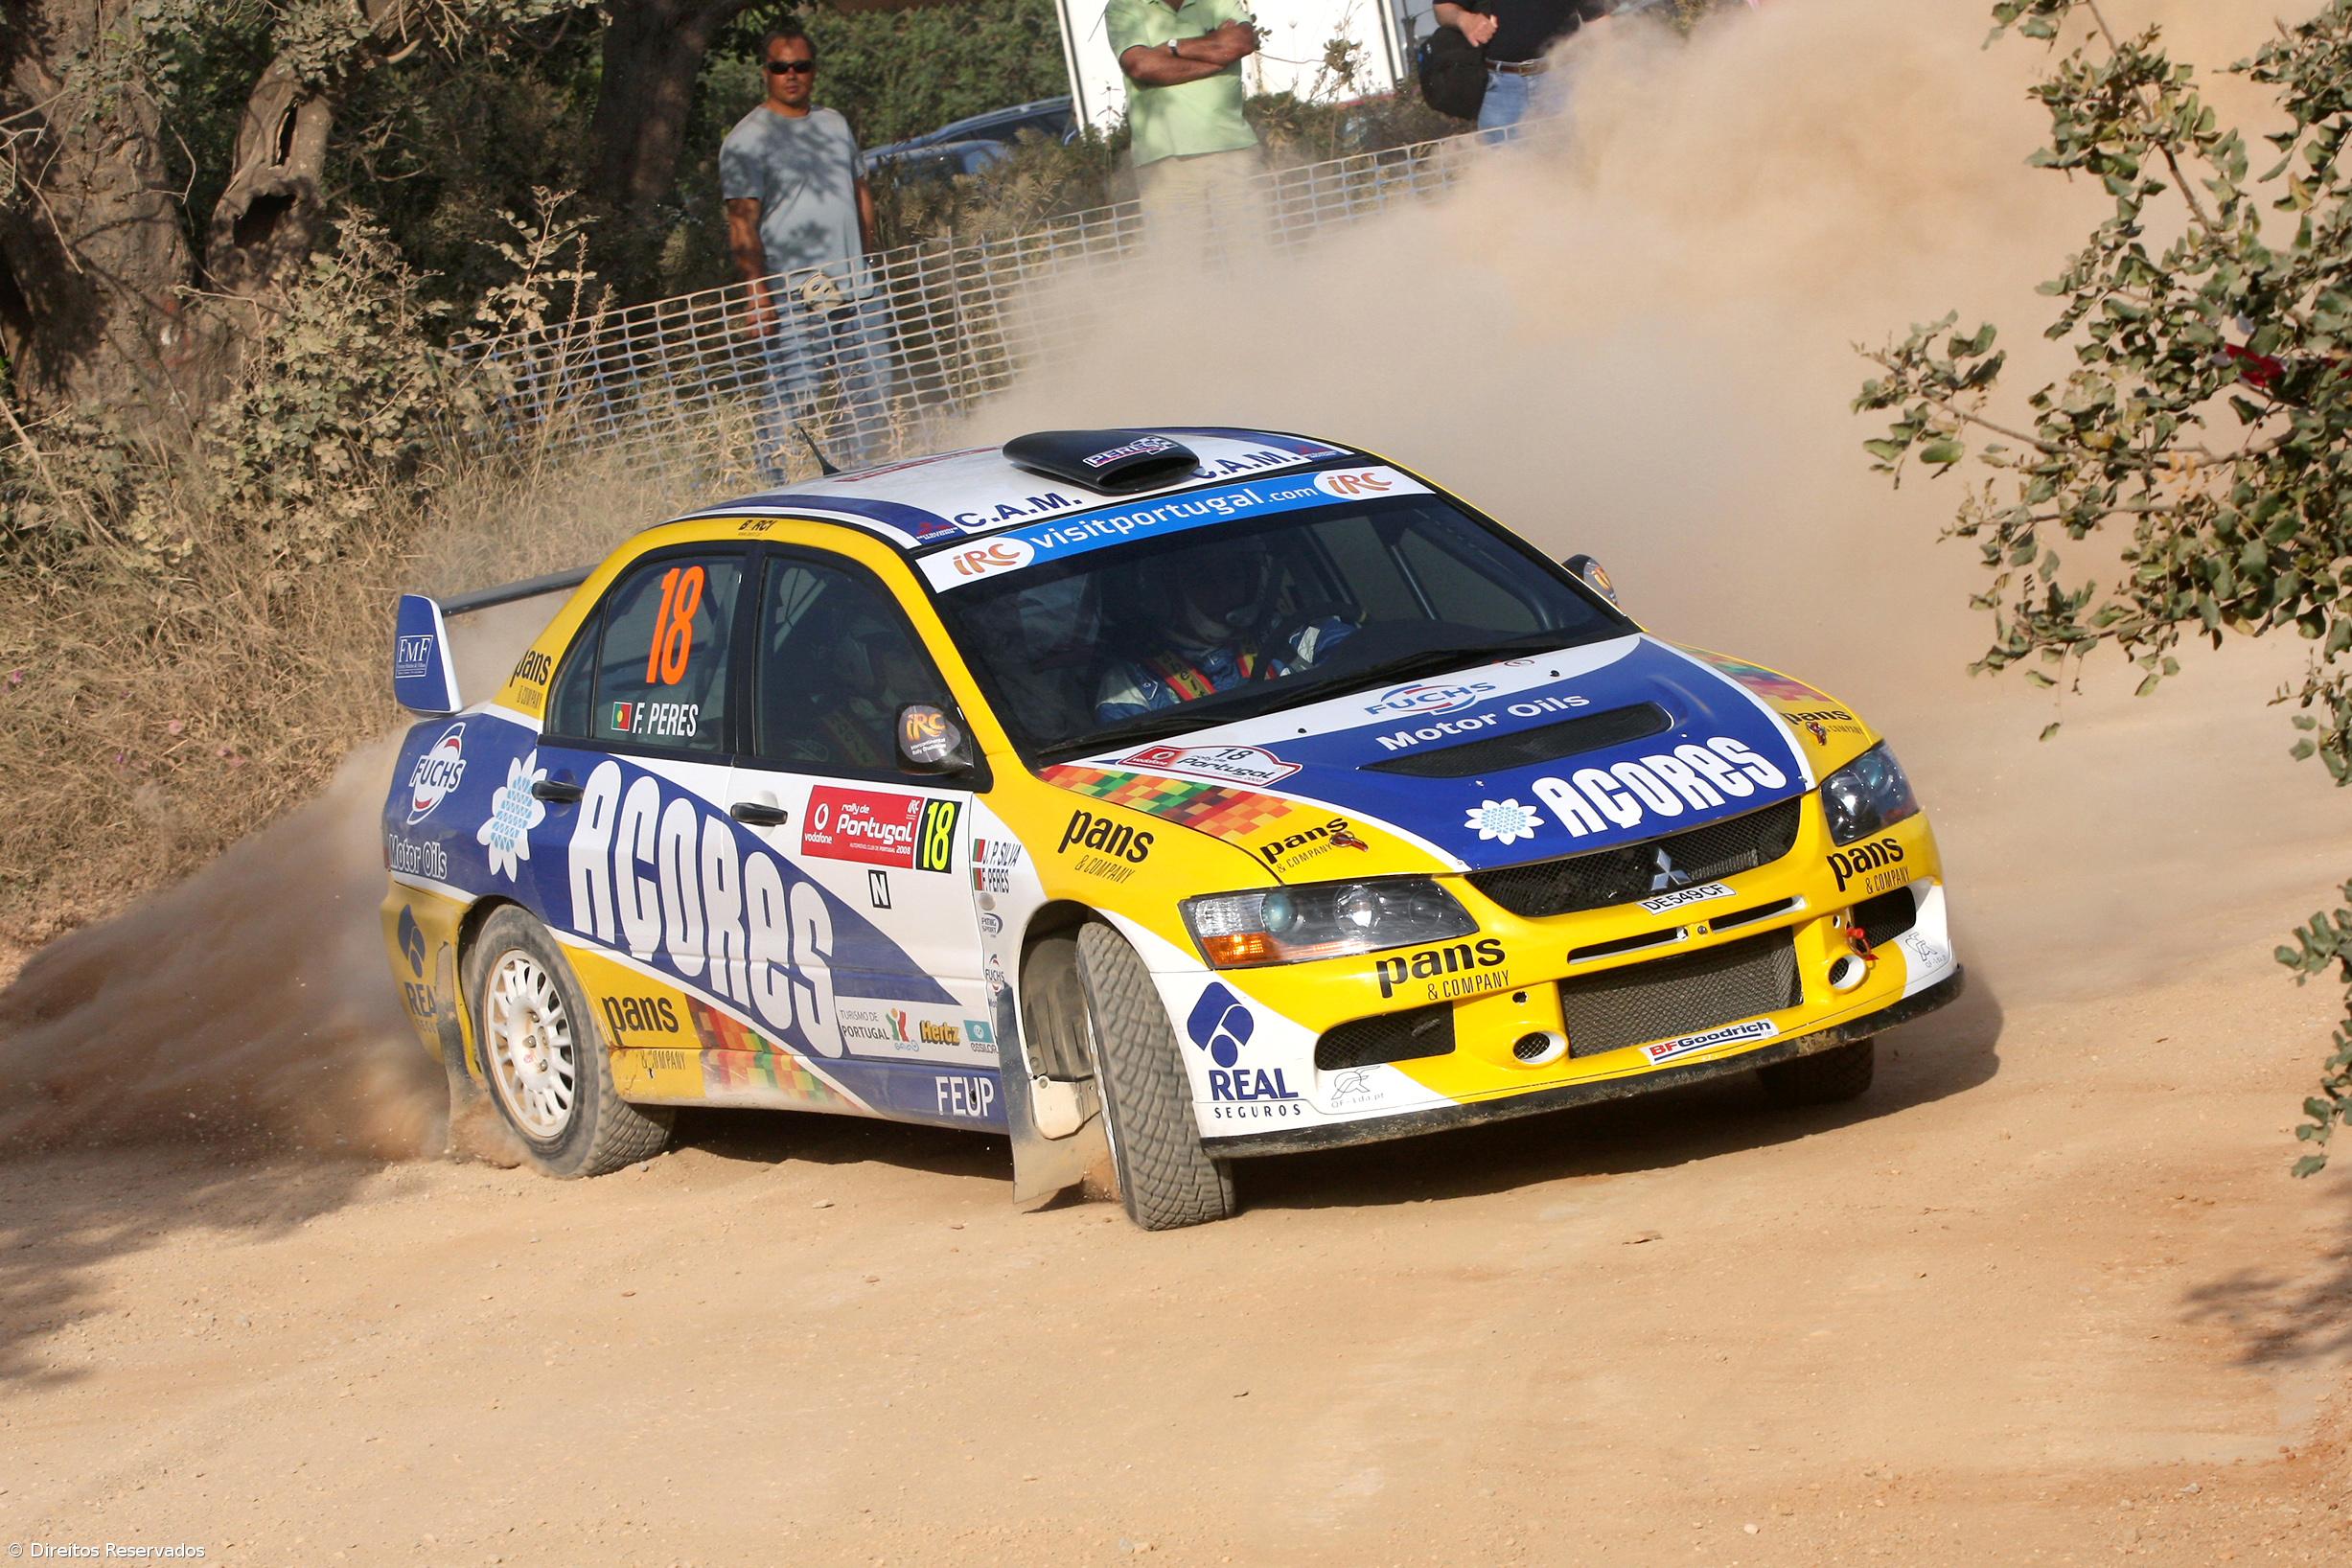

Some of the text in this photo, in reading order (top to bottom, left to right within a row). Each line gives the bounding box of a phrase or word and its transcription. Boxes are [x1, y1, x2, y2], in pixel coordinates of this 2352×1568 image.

[954, 493, 1083, 527] C.A.M.
[1029, 487, 1319, 549] visitportugal.com
[646, 566, 705, 685] 18
[1364, 681, 1496, 715] FUCHS
[633, 702, 699, 736] F. PERES
[1375, 693, 1591, 751] Motor Oils
[1176, 757, 1276, 779] Portugal
[1214, 748, 1255, 762] 18
[411, 758, 466, 790] FUCHS
[842, 802, 870, 816] rally de
[804, 832, 833, 844] vodafone
[836, 814, 913, 845] Portugal
[922, 801, 957, 871] 18
[1057, 809, 1155, 863] pans
[1258, 818, 1349, 864] pans
[389, 834, 448, 880] Motor Oils
[896, 845, 911, 855] 2008
[997, 842, 1022, 866] SILVA
[1286, 843, 1333, 869] COMPANY
[1826, 838, 1904, 892] pans
[987, 868, 1009, 892] PERES
[1084, 856, 1136, 884] COMPANY
[1874, 866, 1910, 891] COMPANY
[870, 872, 888, 907] N
[985, 968, 1004, 981] FUCHS
[1375, 938, 1506, 999] pans
[404, 981, 438, 1017] REA
[1427, 969, 1510, 1001] & COMPANY
[601, 993, 680, 1047] pans
[840, 1009, 879, 1022] TURISMO DE
[842, 1025, 890, 1041] PORTUGAL
[920, 1020, 960, 1047] Hertz
[1649, 1021, 1771, 1056] BFGoodrich
[934, 1075, 995, 1118] FEUP
[1209, 1068, 1299, 1101] REAL
[1213, 1104, 1301, 1118] SEGUROS
